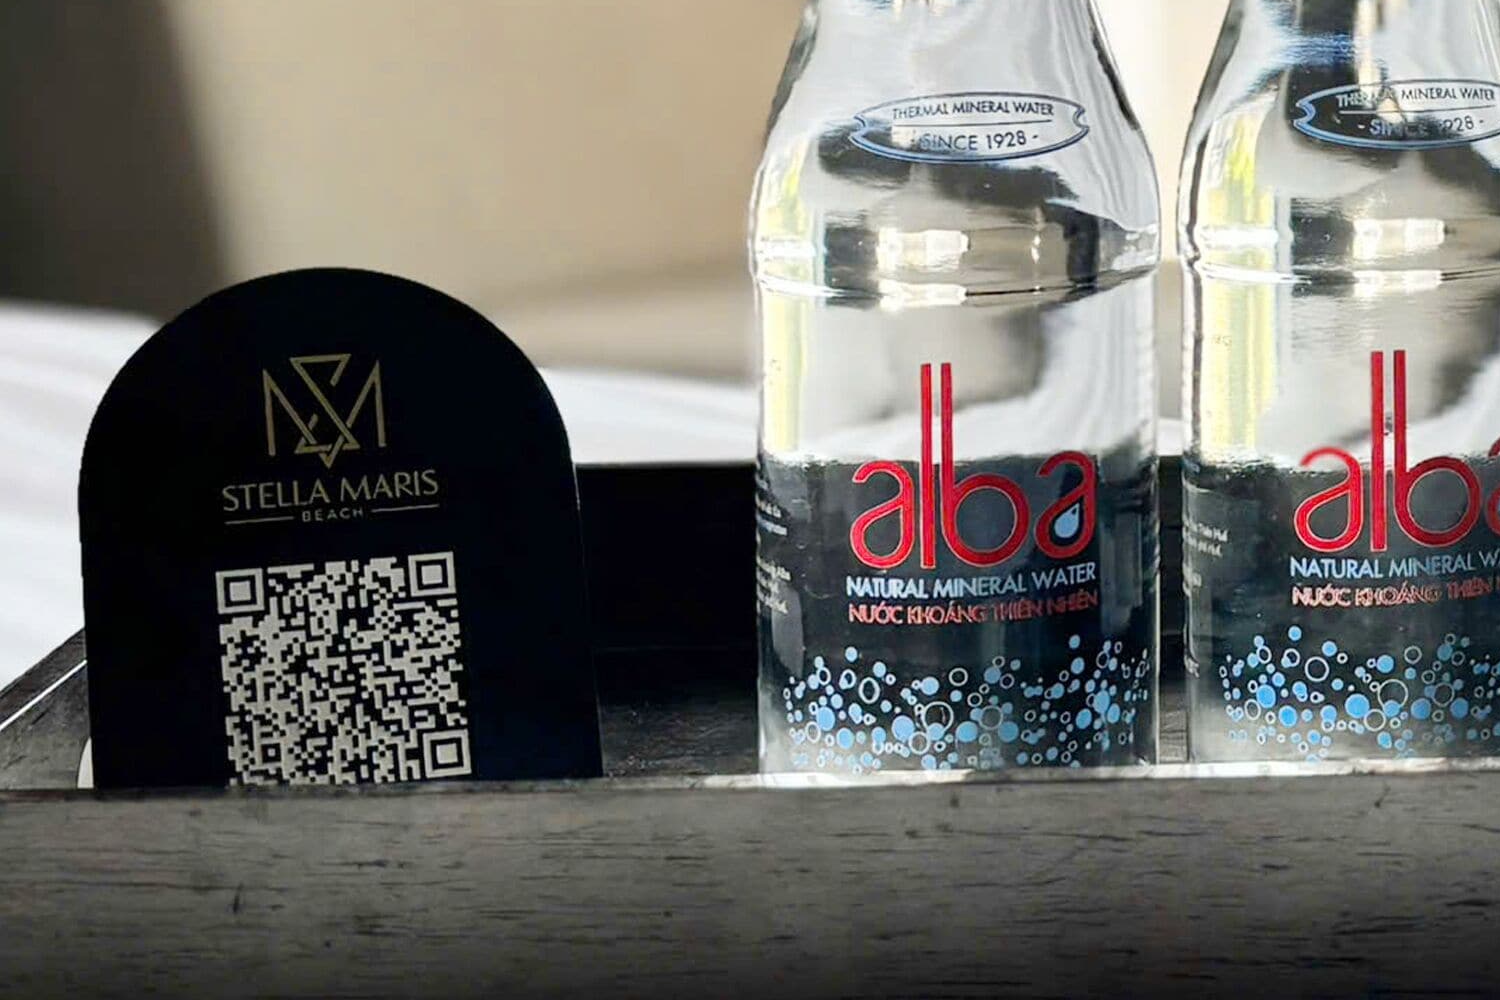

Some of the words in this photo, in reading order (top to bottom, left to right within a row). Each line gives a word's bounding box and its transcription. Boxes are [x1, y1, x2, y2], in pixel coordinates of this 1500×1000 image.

[1401, 87, 1458, 102] MINERAL
[1460, 87, 1496, 101] WATER
[892, 104, 949, 119] THERMAL
[952, 102, 1010, 117] MINERAL
[1013, 101, 1055, 116] WATER
[919, 132, 978, 151] SINCE
[986, 130, 1027, 150] 1928
[849, 362, 1097, 570] alba
[222, 479, 331, 512] STELLA
[339, 469, 439, 503] MARIS
[301, 507, 364, 523] BEACH
[1289, 556, 1384, 580] NATURAL
[1388, 553, 1477, 578] MINERAL
[845, 575, 929, 599] NATURAL
[932, 573, 1027, 598] MINERAL
[1030, 561, 1097, 590] WATER
